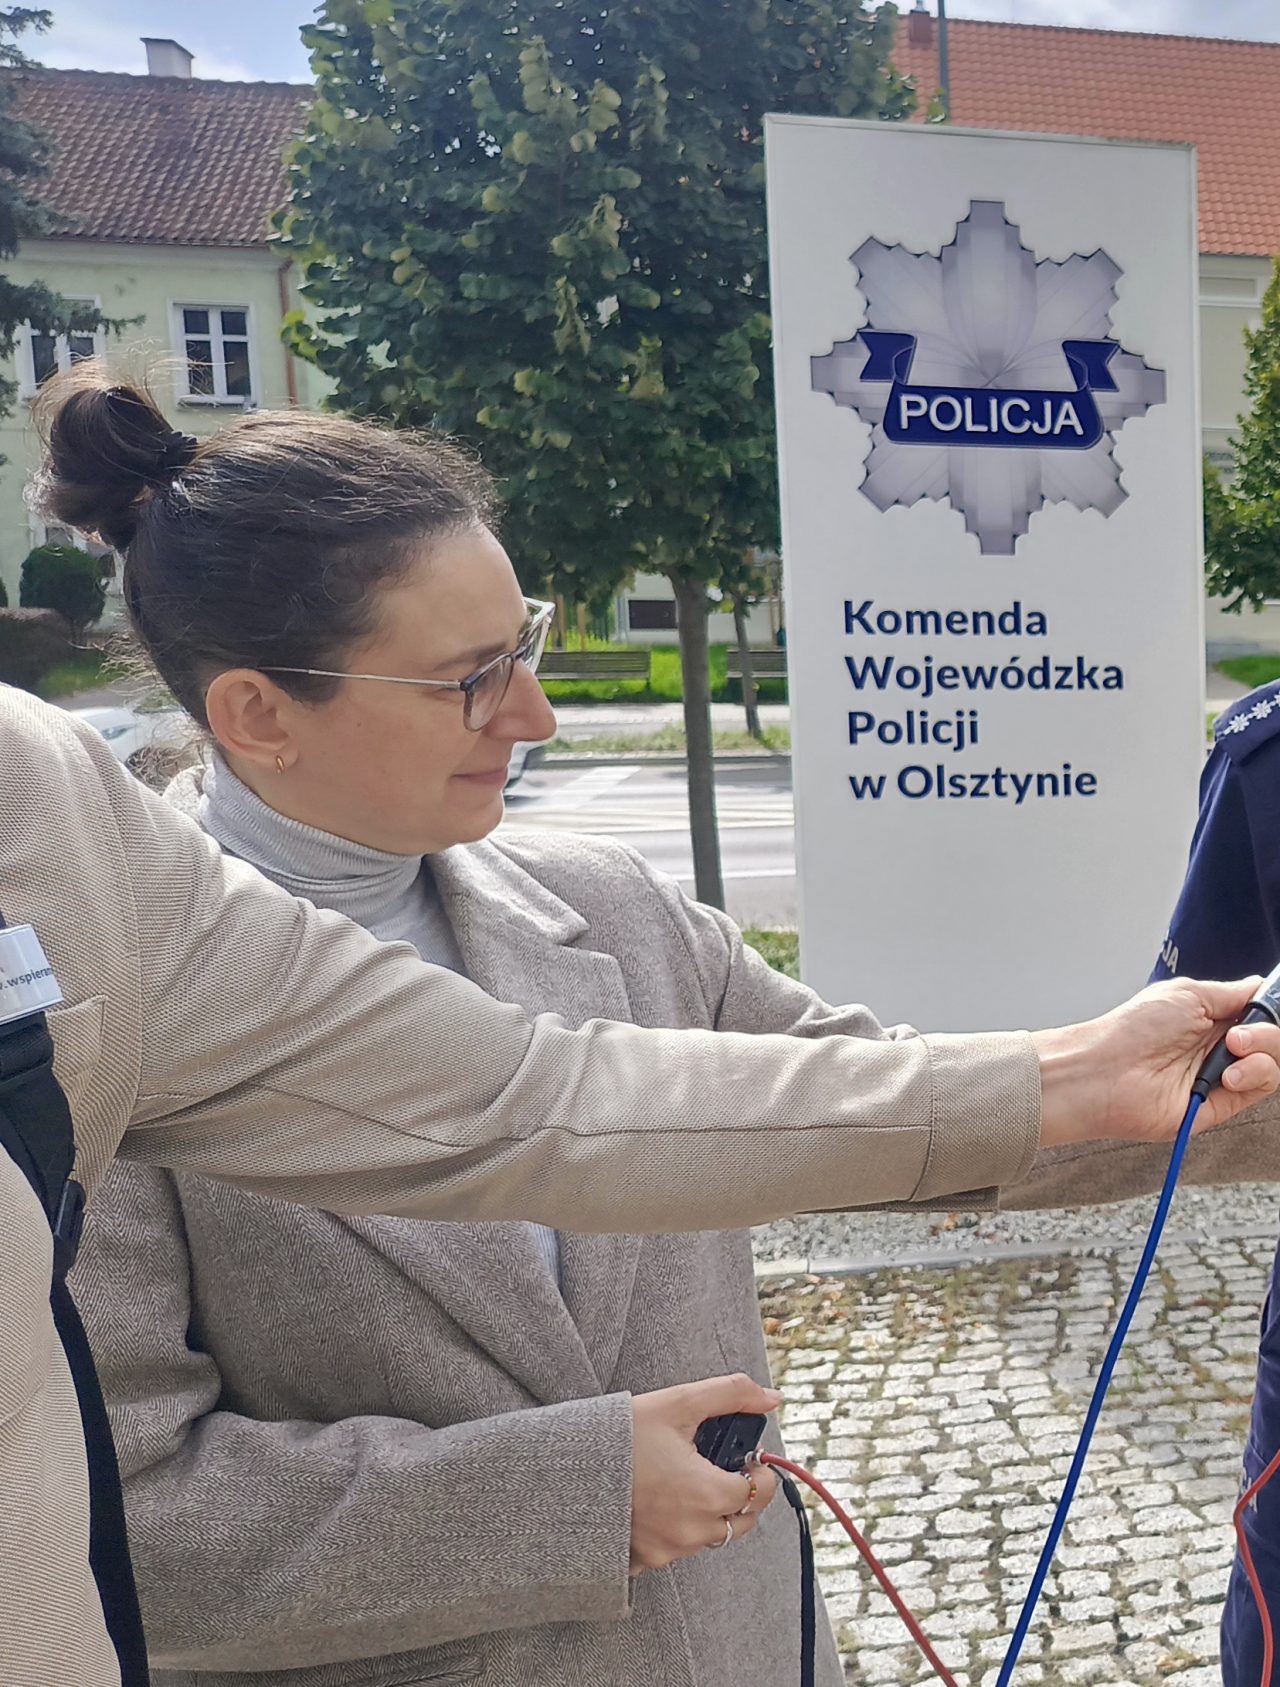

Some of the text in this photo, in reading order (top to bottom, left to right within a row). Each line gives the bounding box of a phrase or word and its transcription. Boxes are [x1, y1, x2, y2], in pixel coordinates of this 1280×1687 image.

[899, 394, 1084, 435] POLICJA
[843, 600, 1048, 636] Komenda
[844, 655, 1124, 698] Wojewódzka
[848, 710, 979, 752] Policji
[849, 763, 1098, 804] w Olsztynie
